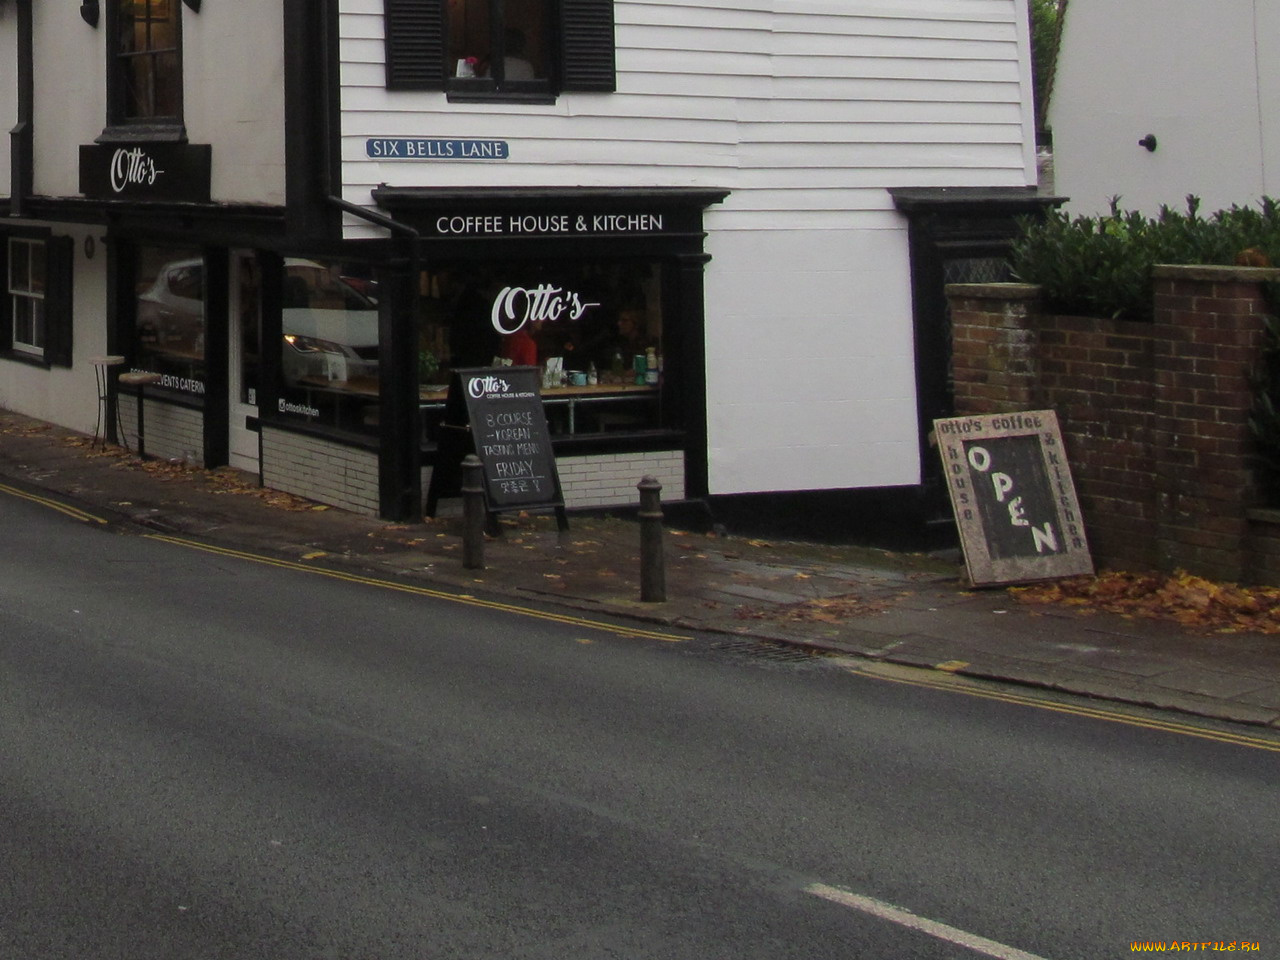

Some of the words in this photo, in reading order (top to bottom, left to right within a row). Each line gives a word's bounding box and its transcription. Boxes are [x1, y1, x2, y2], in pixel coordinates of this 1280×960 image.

[373, 141, 399, 156] SIX
[406, 141, 454, 157] BELLS
[461, 142, 503, 157] LANE
[110, 147, 164, 193] Otto's
[436, 216, 503, 233] COFFEE
[509, 215, 569, 232] HOUSE
[575, 215, 587, 231] &
[592, 214, 663, 231] KITCHEN
[491, 283, 600, 335] Otto's
[157, 374, 179, 389] VENTS
[180, 377, 206, 394] CATERIN
[468, 376, 511, 398] Otto's
[497, 412, 533, 426] COURSE
[992, 415, 1042, 431] coffee
[482, 444, 514, 456] TASTING
[516, 442, 539, 455] MENU
[496, 460, 534, 478] FRIDAY
[968, 446, 1058, 553] OPEN
